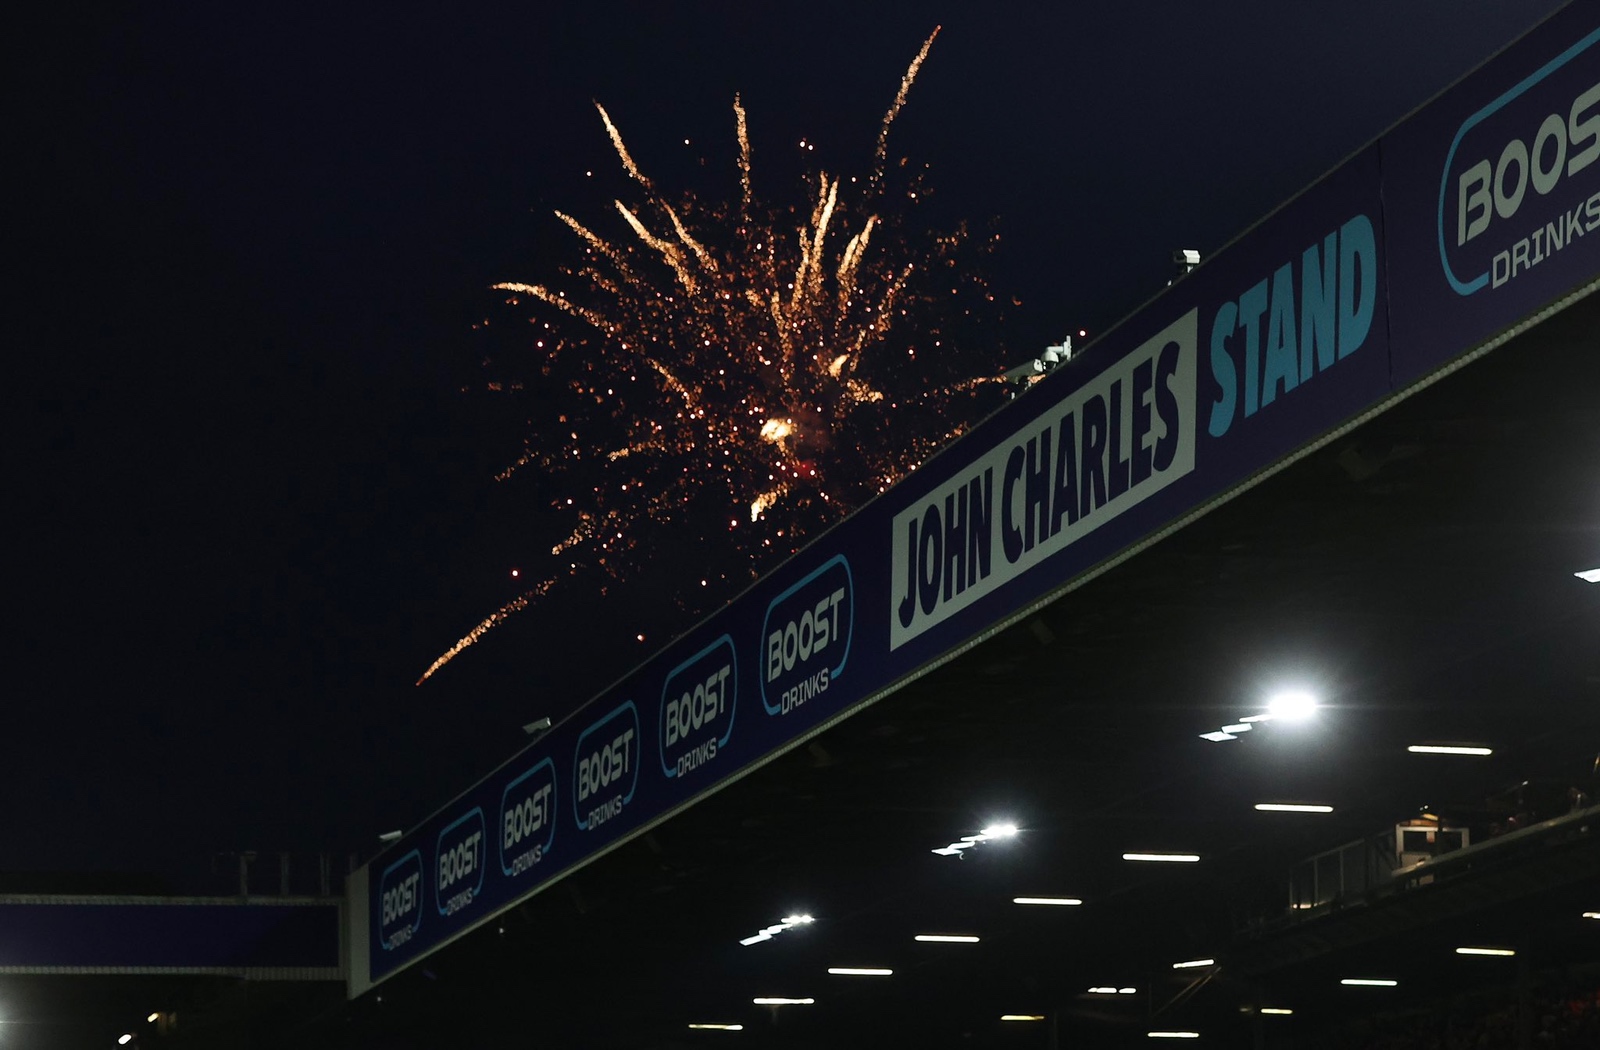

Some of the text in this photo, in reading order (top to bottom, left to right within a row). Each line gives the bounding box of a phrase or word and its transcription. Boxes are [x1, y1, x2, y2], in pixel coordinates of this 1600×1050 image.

[1492, 191, 1600, 289] DRINKS
[898, 214, 1377, 628] JOHN CHARLES STAND
[767, 587, 845, 683] BOOST
[666, 664, 730, 748] BOOST
[781, 667, 829, 715] DRINKS
[578, 728, 634, 802] BOOST
[677, 737, 717, 778] DRINKS
[503, 783, 552, 850] BOOST
[588, 794, 622, 831] DRINKS
[439, 831, 481, 891] BOOST
[512, 844, 542, 877] DRINKS
[382, 871, 420, 927] BOOST
